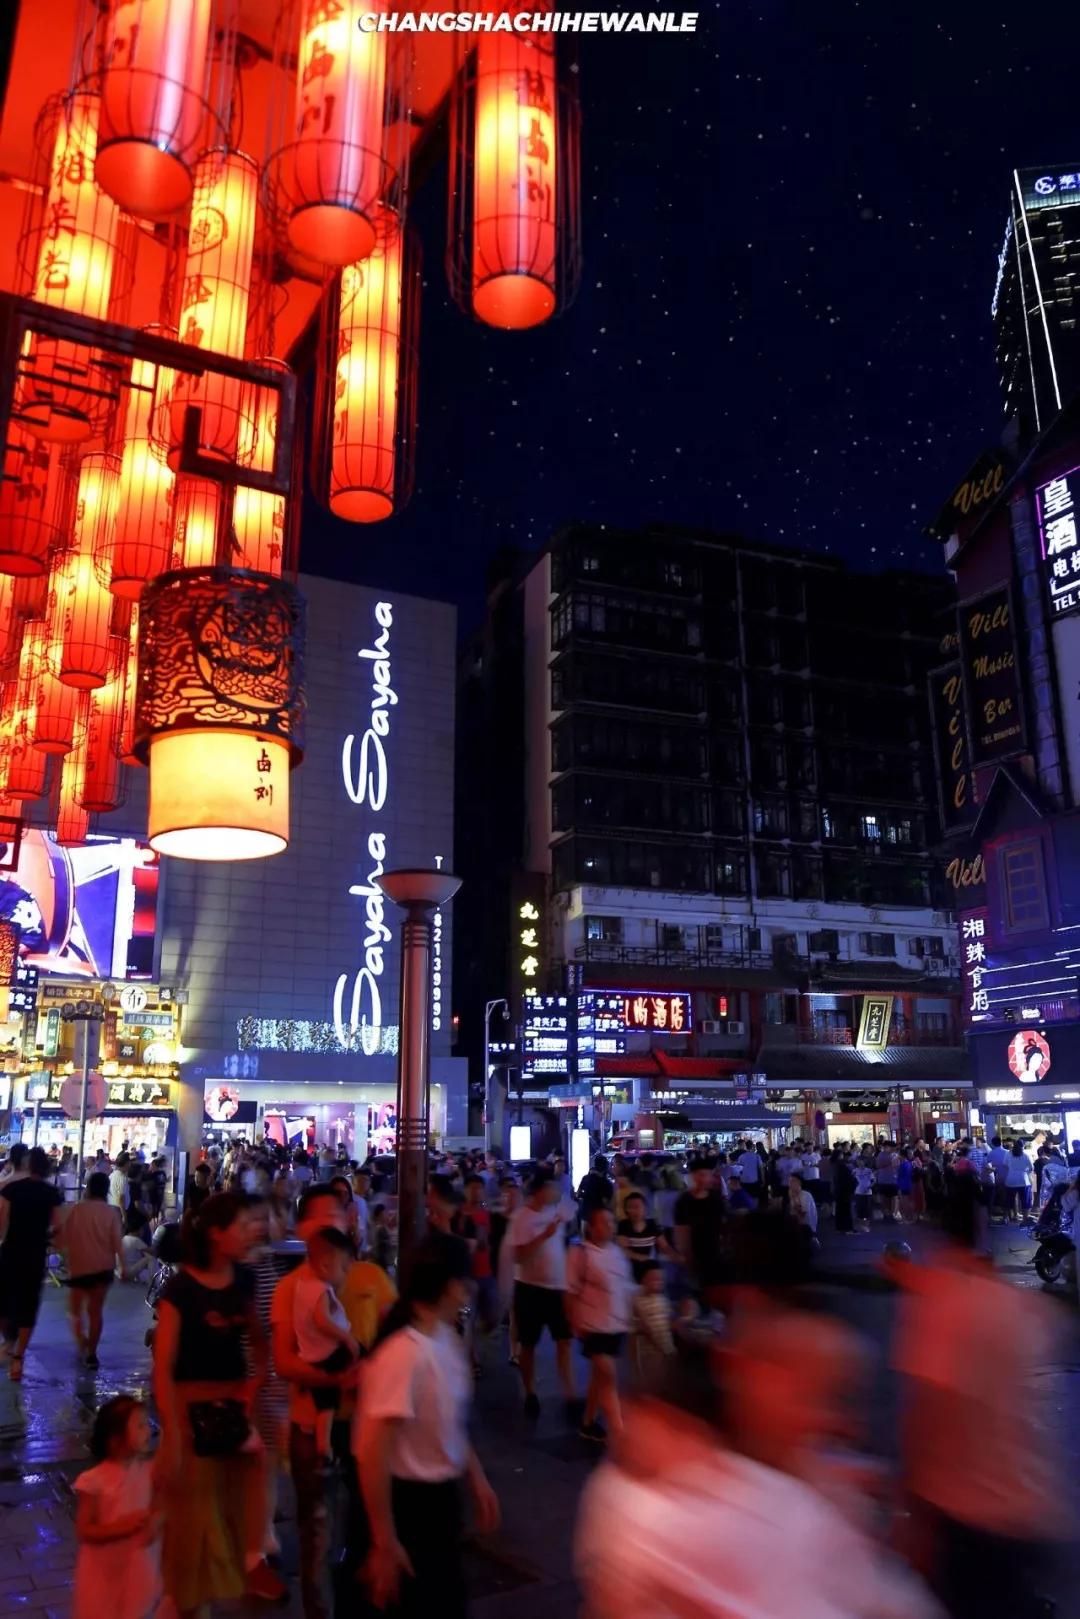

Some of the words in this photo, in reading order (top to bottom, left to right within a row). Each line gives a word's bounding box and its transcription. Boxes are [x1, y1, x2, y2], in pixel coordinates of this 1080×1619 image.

[973, 653, 1014, 678] Music
[342, 602, 398, 811] Sayaha
[984, 699, 1012, 724] Bar
[333, 832, 392, 1056] Sayaha
[962, 918, 989, 1012] 湘辣食府
[868, 1006, 882, 1040] 九芝堂
